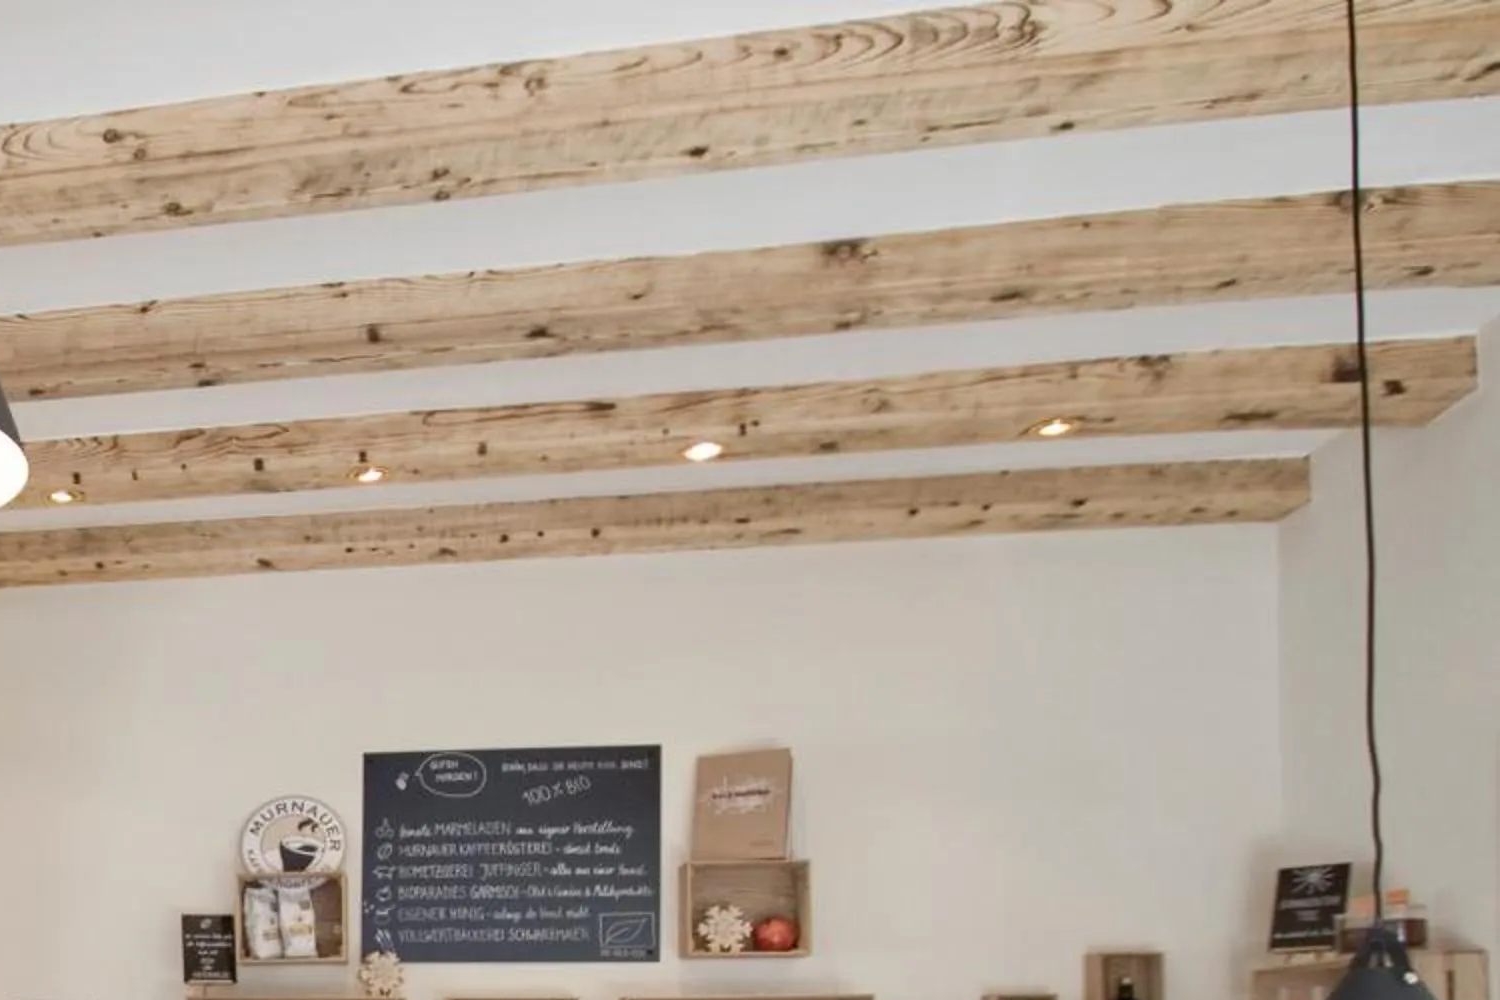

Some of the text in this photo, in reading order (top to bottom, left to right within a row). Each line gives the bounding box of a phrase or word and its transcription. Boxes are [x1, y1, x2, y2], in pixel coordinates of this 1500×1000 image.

[565, 774, 593, 795] BIO
[249, 800, 341, 851] MURNAUER
[434, 821, 511, 836] MARMELADEN
[398, 843, 457, 857] MURNAUER
[398, 885, 467, 900] BIOPARADIES
[469, 884, 519, 899] GARMISCH
